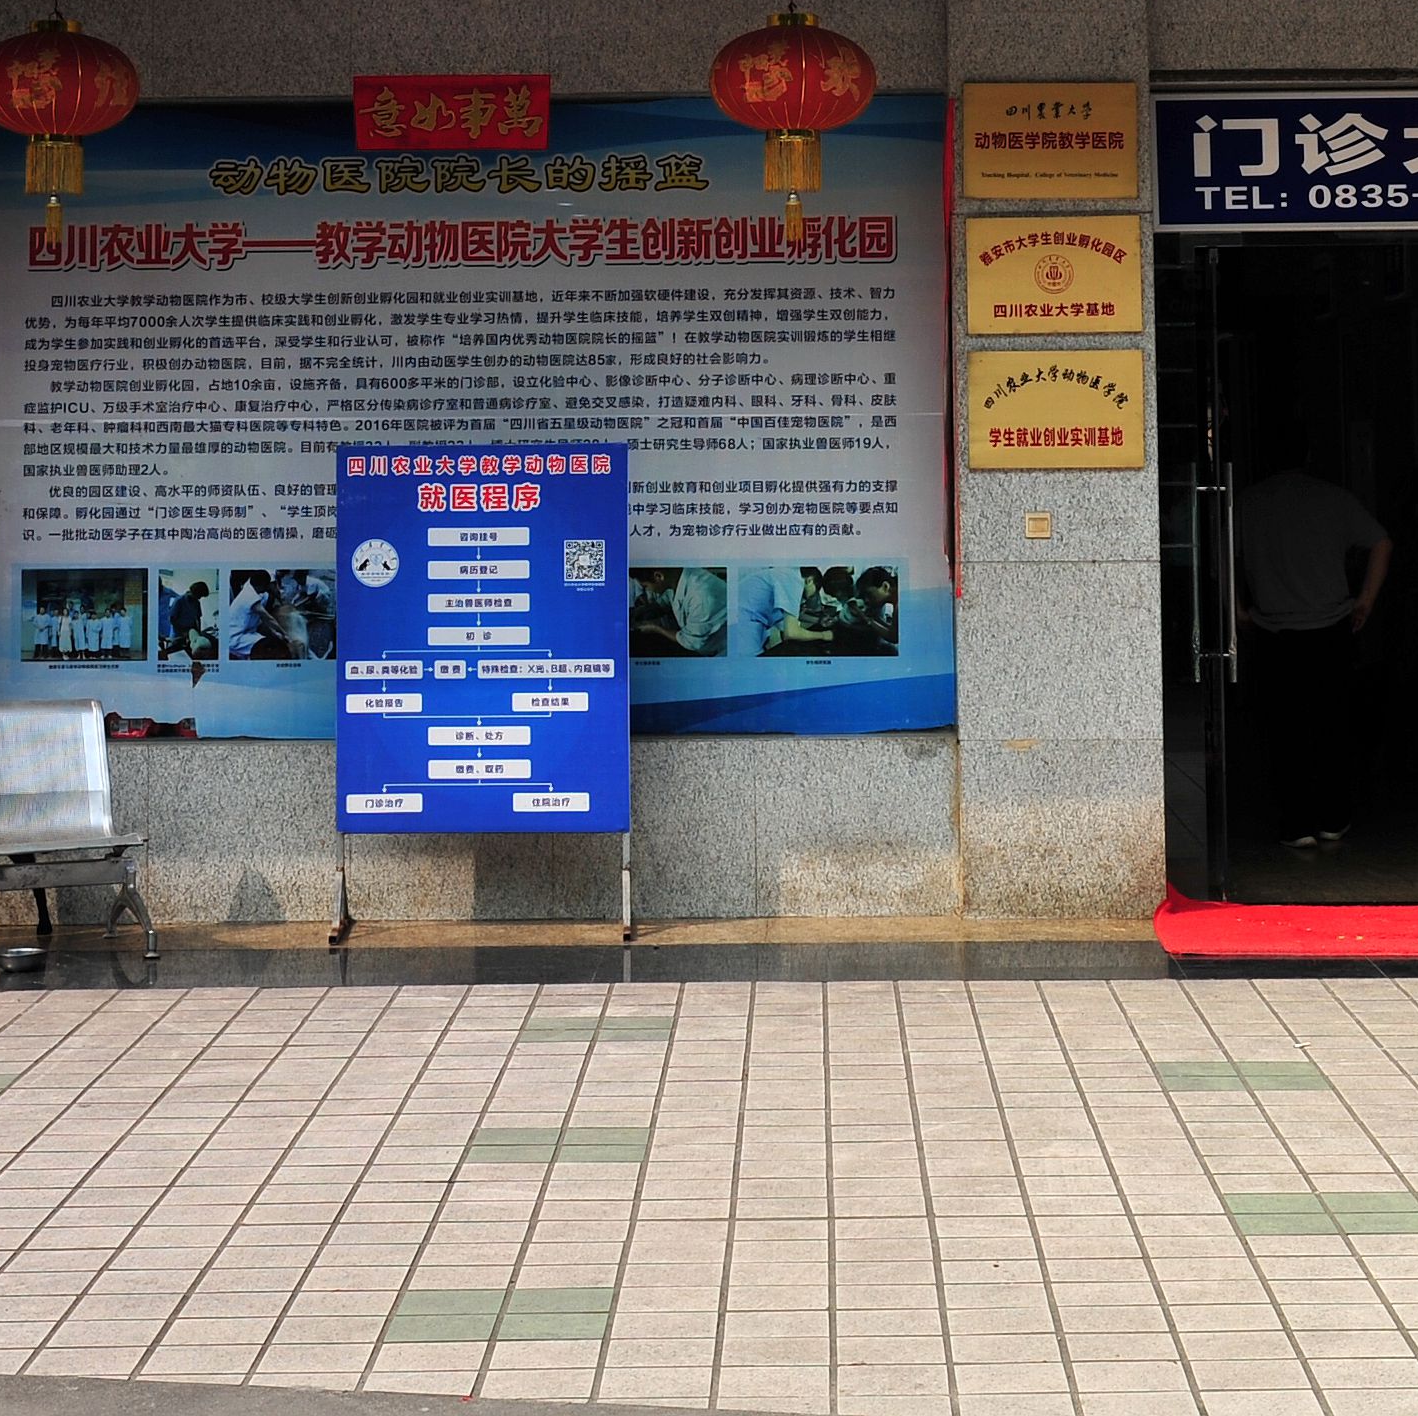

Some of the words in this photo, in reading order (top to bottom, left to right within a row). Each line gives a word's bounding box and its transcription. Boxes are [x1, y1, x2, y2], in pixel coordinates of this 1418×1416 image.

[974, 131, 1125, 151] 动物医学院教学医院
[208, 154, 712, 197] 动物医院院长的摇篮
[979, 230, 1128, 267] 雅安市大学生创业孵化园区
[993, 301, 1116, 319] 四川农业大学基地
[988, 425, 1124, 448] 学生就业创业实训基地
[22, 463, 170, 478] 国家执业兽医师助理2人。
[347, 454, 612, 476] 四川农业大学教学动物医院
[417, 483, 541, 512] 就医程序
[628, 501, 899, 517] 中学习临床技能，学习创办宠物医院等要点知
